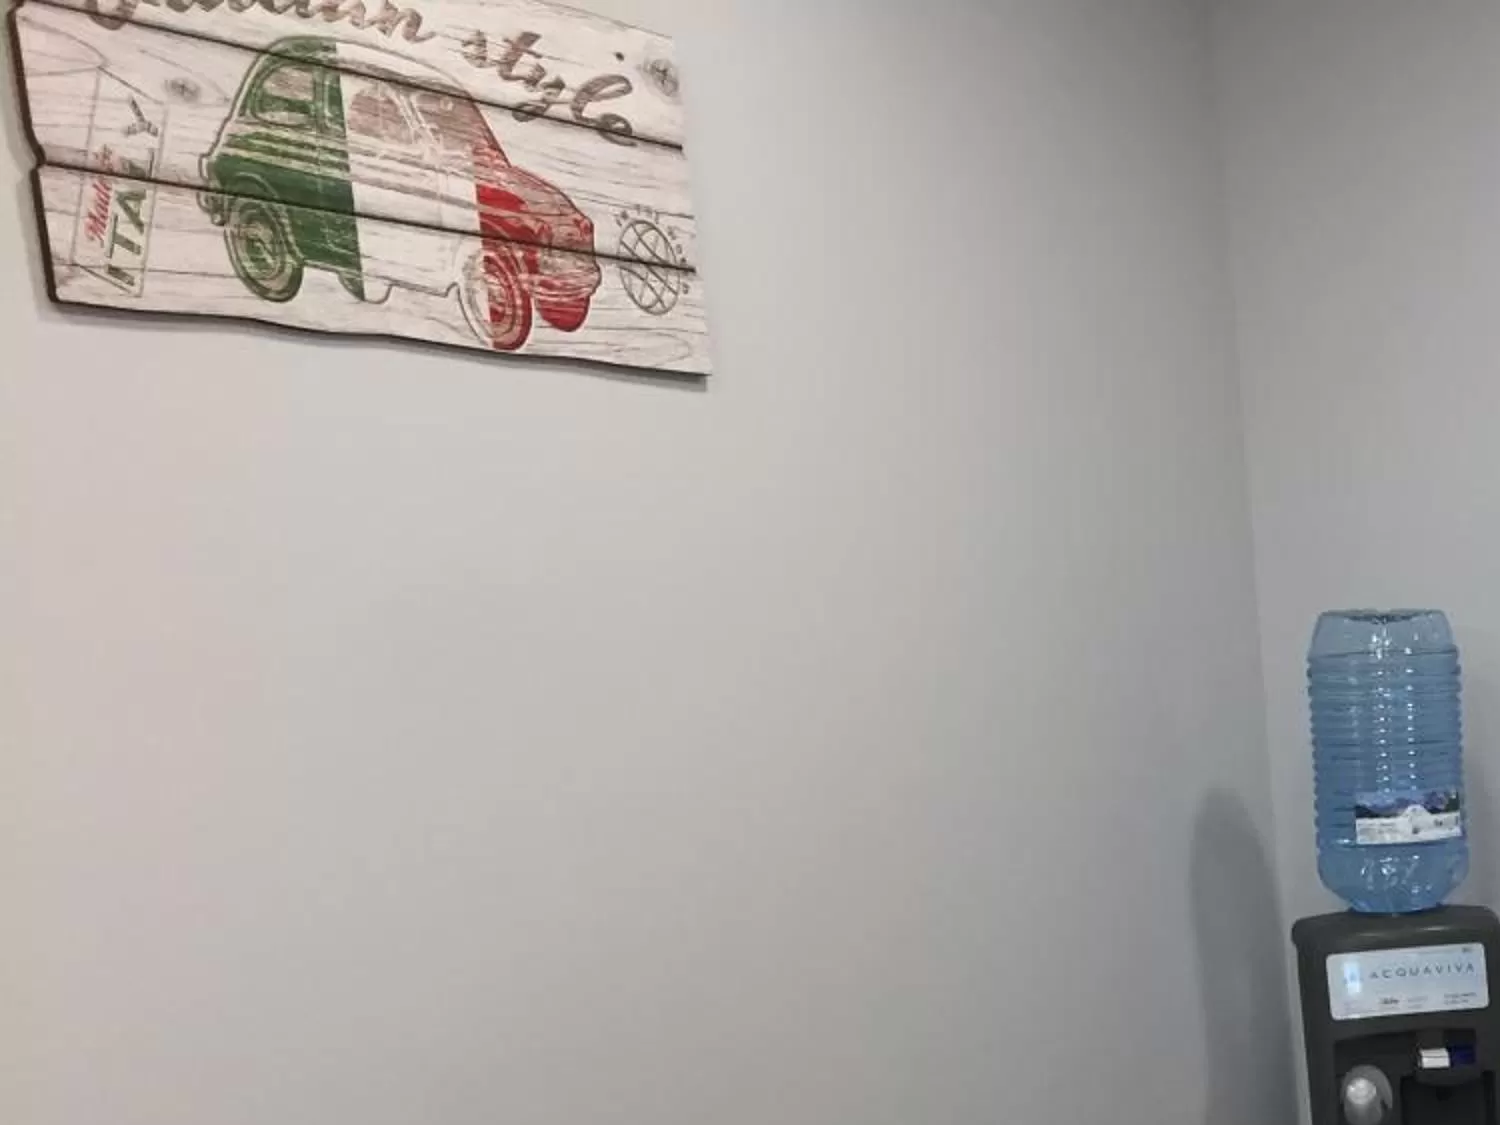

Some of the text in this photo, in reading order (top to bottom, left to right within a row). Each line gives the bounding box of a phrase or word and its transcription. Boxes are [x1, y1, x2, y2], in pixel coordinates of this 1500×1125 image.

[461, 29, 637, 147] style
[105, 95, 159, 287] ITALY
[1369, 961, 1476, 980] ACQUAVIVA
